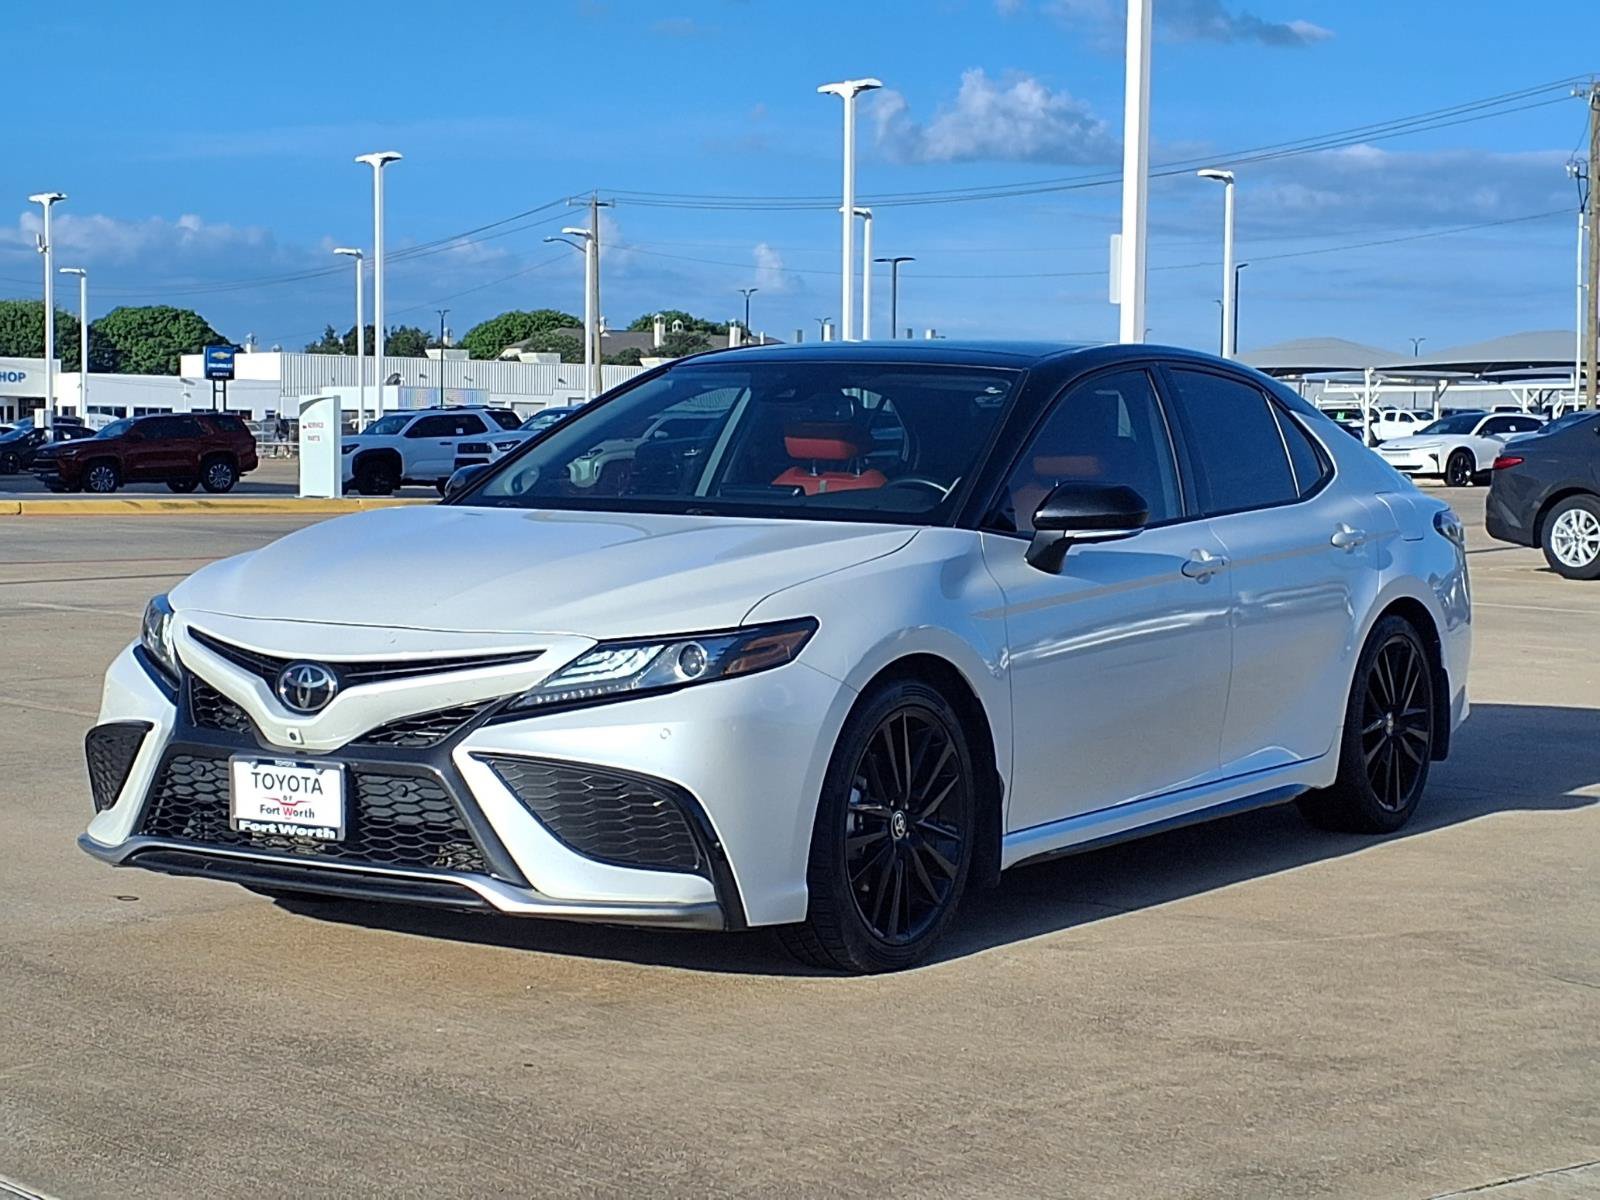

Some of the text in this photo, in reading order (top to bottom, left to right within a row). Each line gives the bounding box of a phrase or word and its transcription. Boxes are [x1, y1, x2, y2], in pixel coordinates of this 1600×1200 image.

[251, 772, 324, 796] TOYOTA
[259, 804, 315, 819] Fort Worth
[238, 820, 336, 839] Fort Worth
